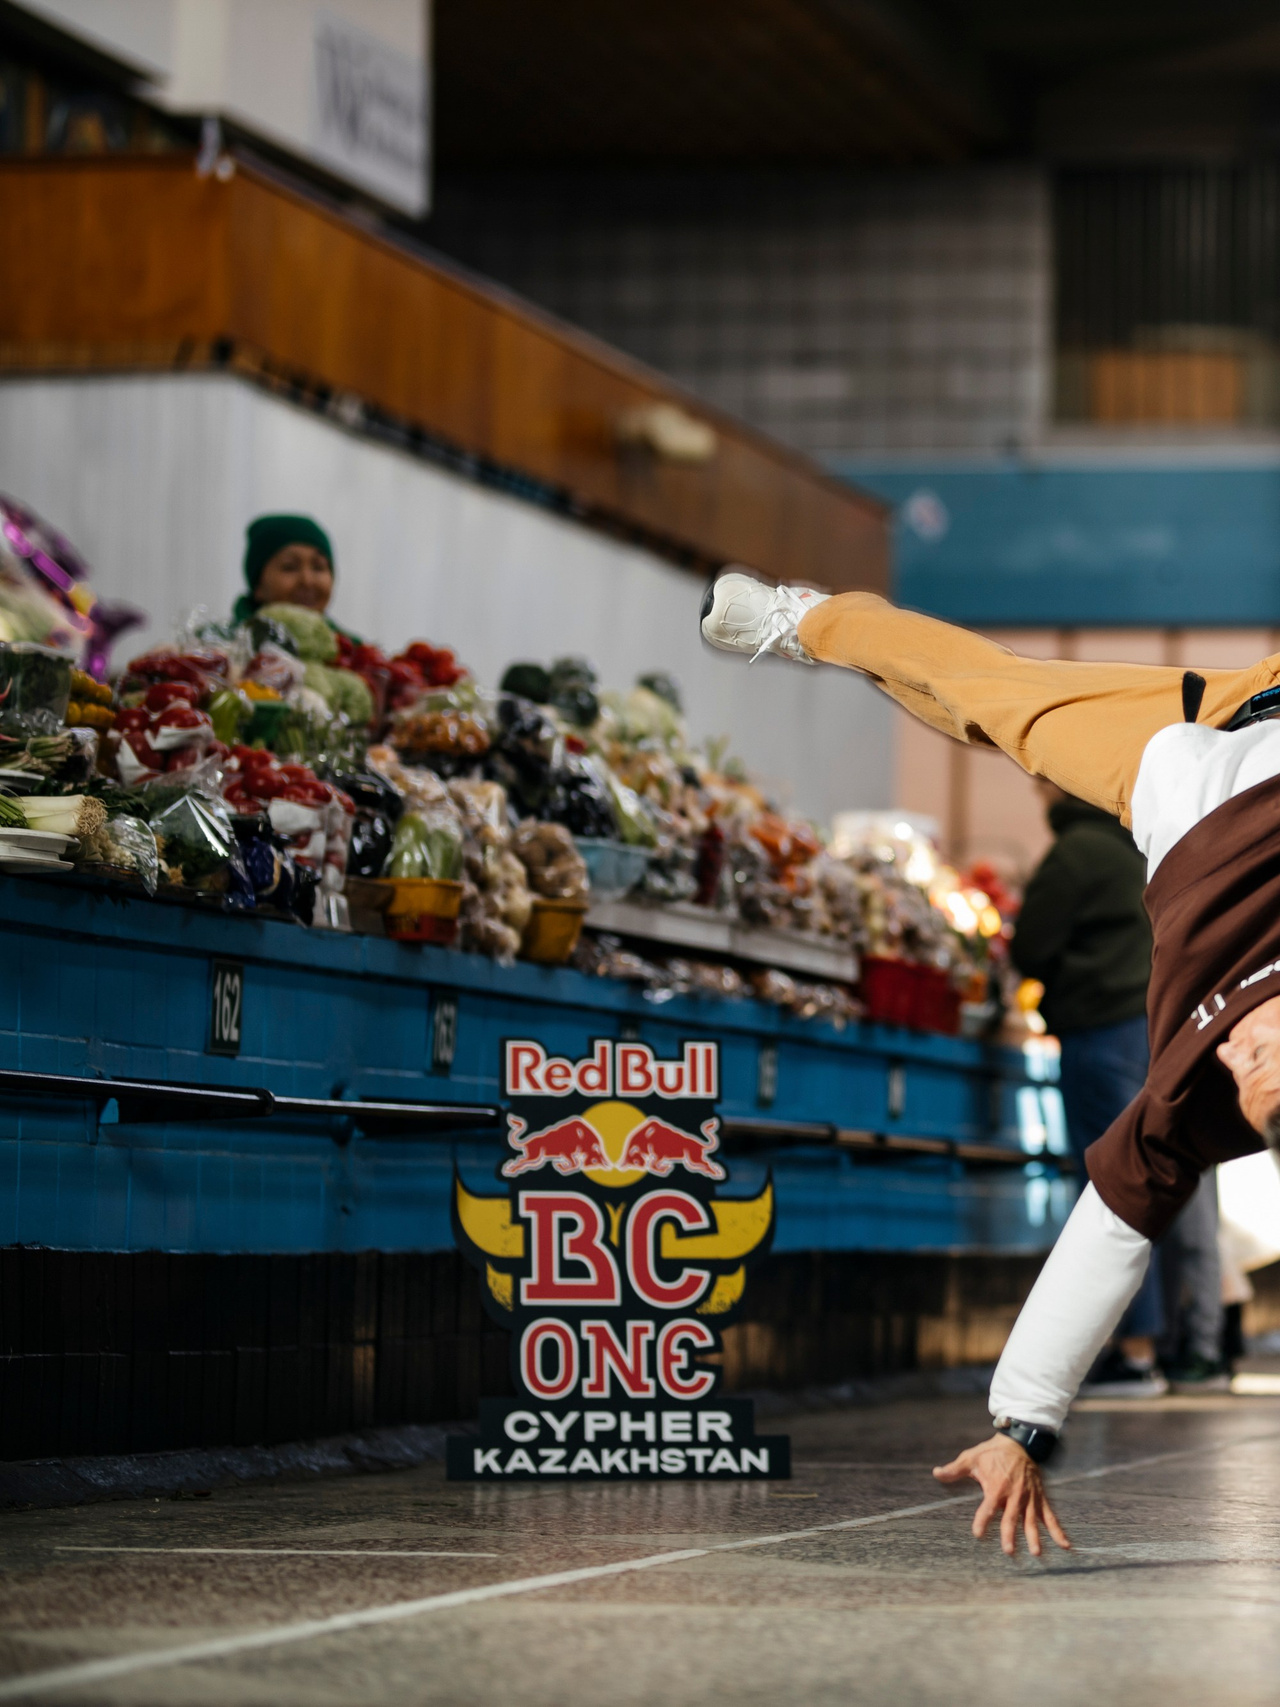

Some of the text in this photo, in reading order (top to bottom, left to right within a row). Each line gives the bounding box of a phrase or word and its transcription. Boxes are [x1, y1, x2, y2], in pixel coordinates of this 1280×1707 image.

[213, 970, 241, 1042] 162
[507, 1040, 612, 1096] Red
[615, 1042, 718, 1098] Bull
[519, 1190, 711, 1309] BC
[520, 1318, 715, 1400] ONE
[504, 1410, 733, 1442] CYPHER
[473, 1448, 770, 1474] KAZAKHSTAN
